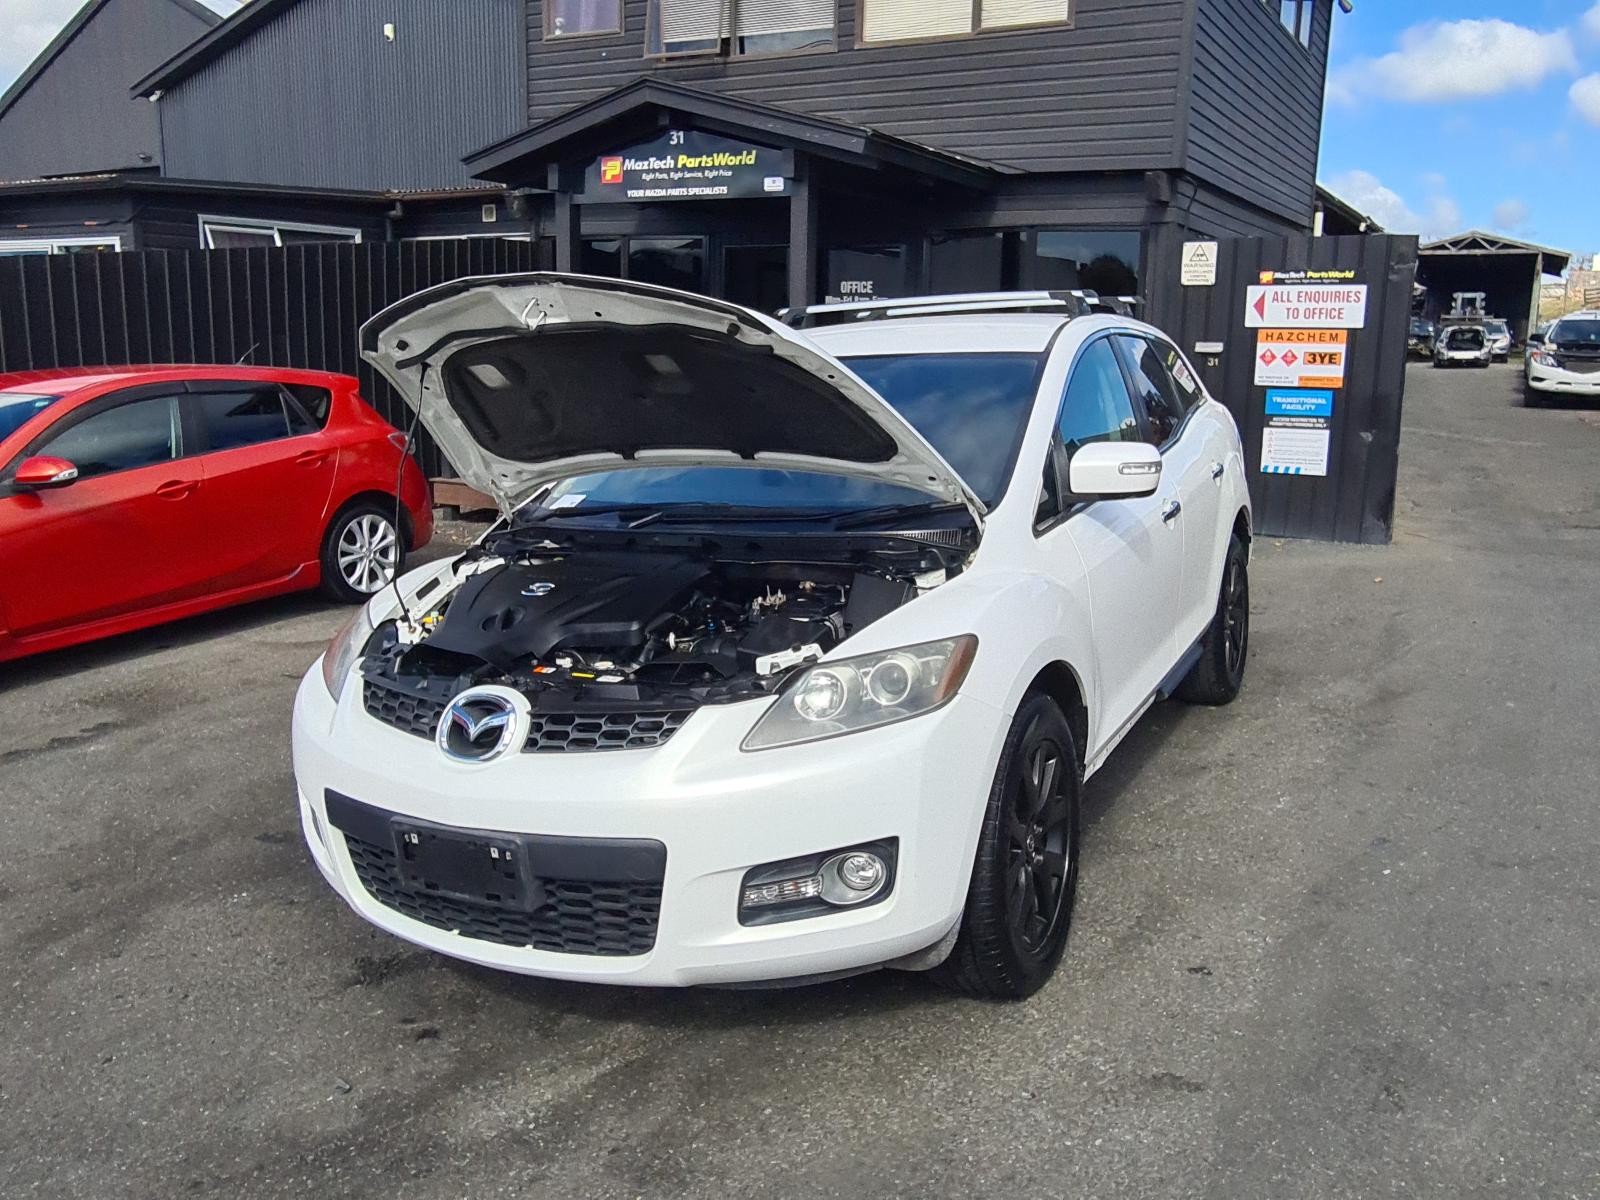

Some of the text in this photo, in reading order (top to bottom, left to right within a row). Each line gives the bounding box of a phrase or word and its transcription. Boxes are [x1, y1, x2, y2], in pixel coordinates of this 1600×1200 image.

[669, 131, 684, 145] 31
[623, 156, 674, 171] MazTech
[677, 150, 756, 168] PartsWorld
[627, 186, 728, 198] YOUR MAZDA PARTS SPECIALISTS
[1306, 270, 1355, 279] PartsWorld
[840, 280, 873, 293] OFFICE
[1272, 290, 1362, 304] ALL ENQUIRIES
[1285, 307, 1345, 320] TO OFFICE
[1265, 331, 1340, 342] HAZCHEM
[1207, 357, 1219, 366] 31
[1307, 352, 1337, 365] 3YE
[1272, 396, 1327, 405] TRANSITIONAL
[1281, 403, 1316, 411] FACILITY
